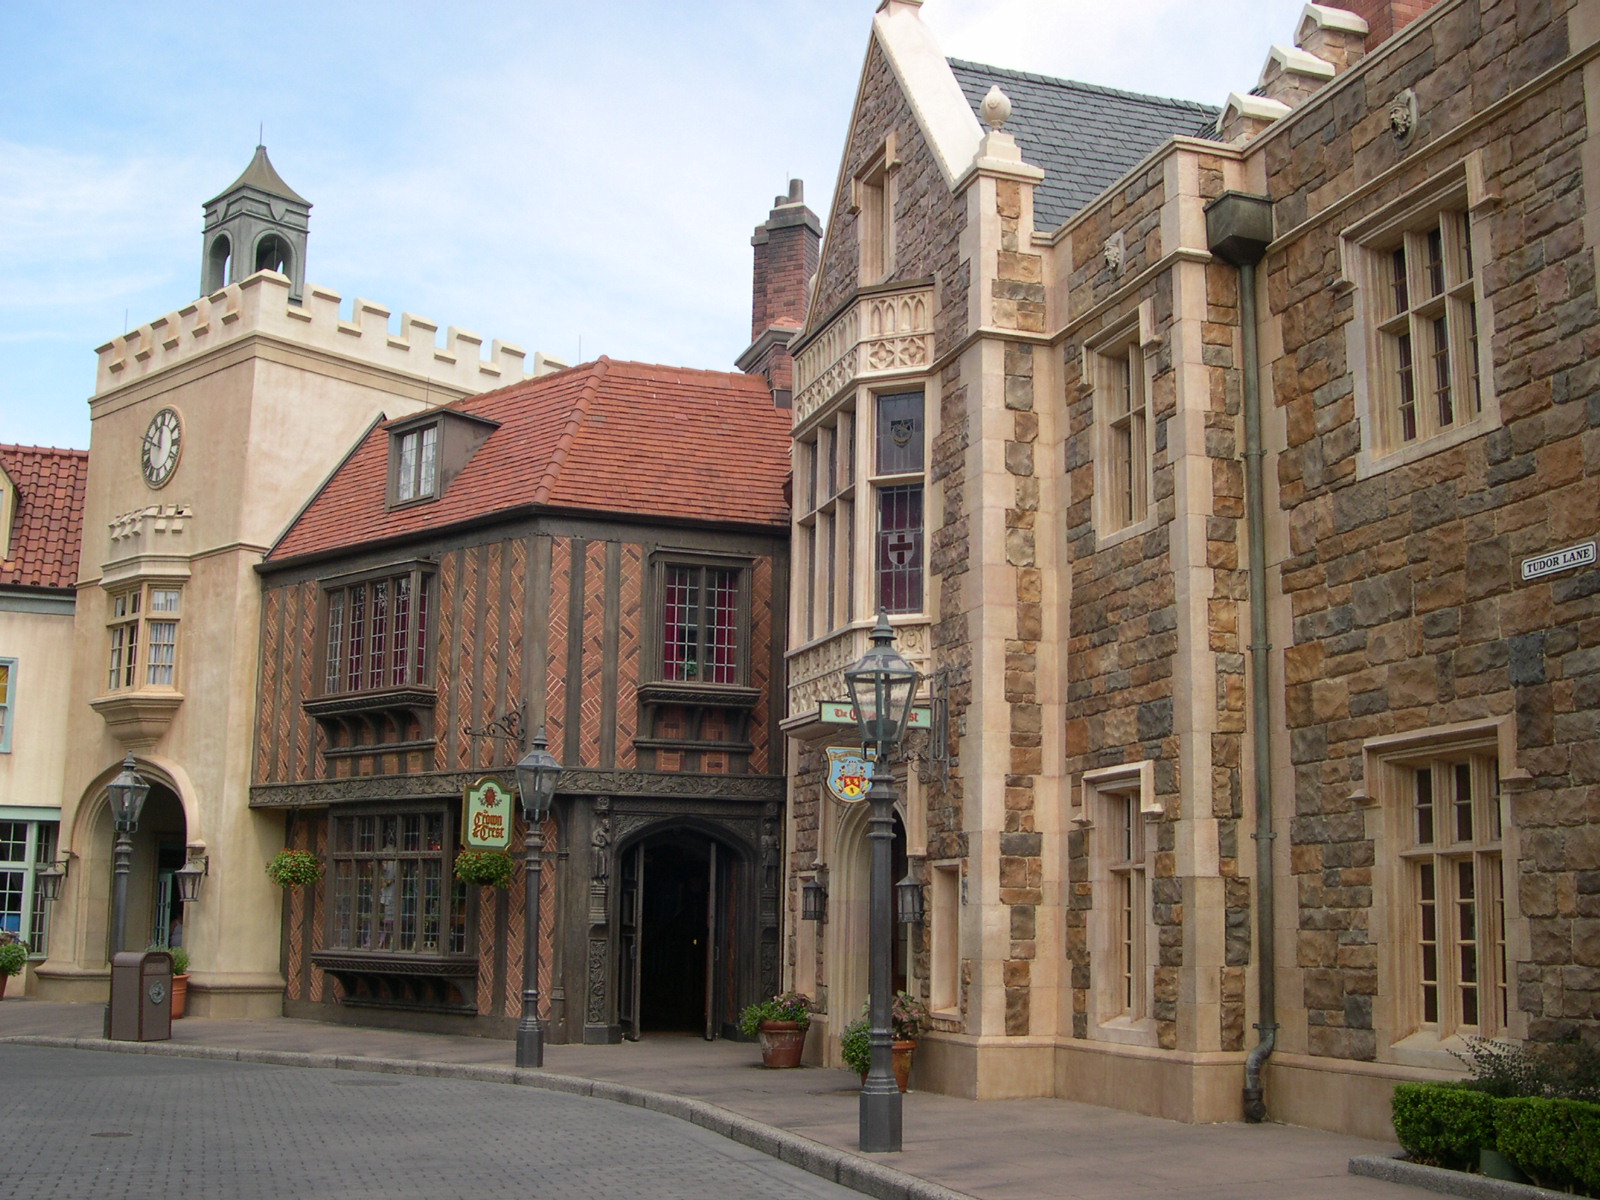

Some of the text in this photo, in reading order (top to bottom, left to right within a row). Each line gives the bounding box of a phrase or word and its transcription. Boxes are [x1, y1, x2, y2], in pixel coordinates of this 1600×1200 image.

[1527, 548, 1591, 573] TUDOR LANE
[474, 811, 503, 827] Crown
[480, 824, 505, 841] Crest
